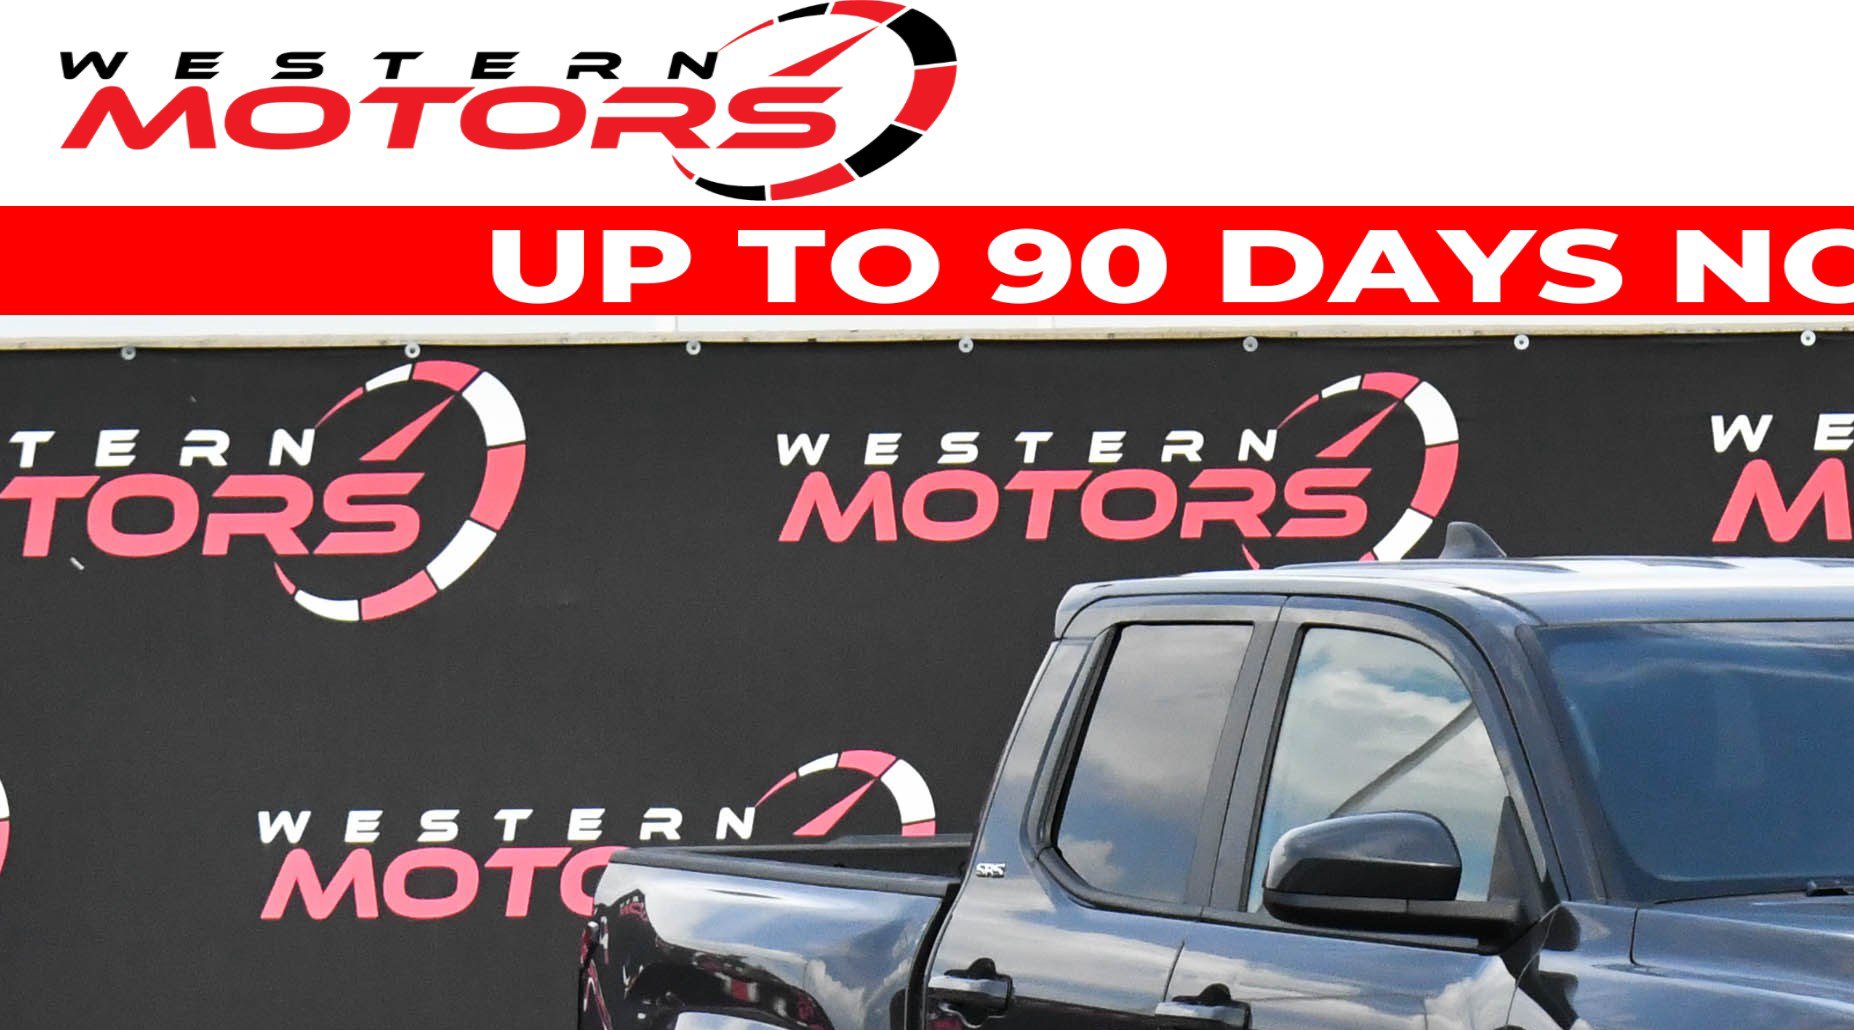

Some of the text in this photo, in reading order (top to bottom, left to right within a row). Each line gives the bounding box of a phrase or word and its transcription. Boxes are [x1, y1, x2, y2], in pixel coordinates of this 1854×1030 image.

[10, 429, 315, 467] TERN
[777, 429, 1277, 465] WESTERN
[0, 472, 424, 557] TORS
[779, 468, 1371, 542] MOTORS
[258, 807, 755, 844] WESTERN
